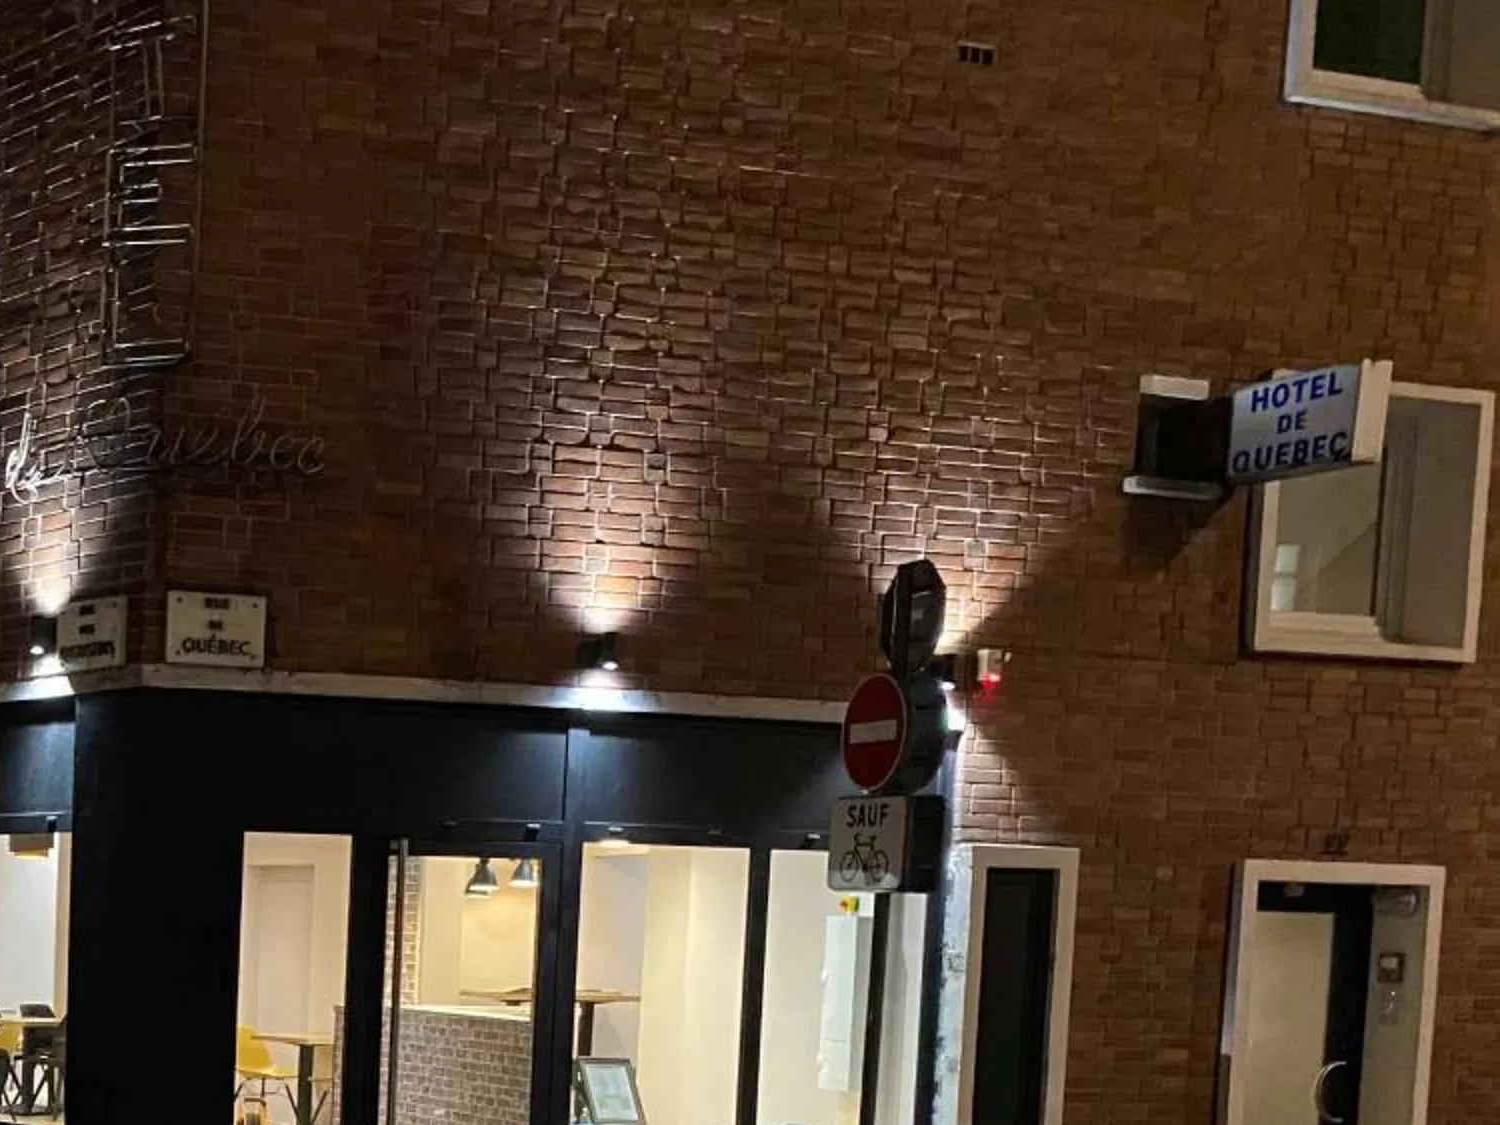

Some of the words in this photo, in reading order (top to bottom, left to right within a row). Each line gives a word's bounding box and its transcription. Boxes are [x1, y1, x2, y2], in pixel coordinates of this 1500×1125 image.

[1251, 371, 1343, 412] HOTEL
[1276, 409, 1308, 435] DE
[1232, 431, 1350, 474] QUEBEC
[845, 803, 890, 828] SAUF
